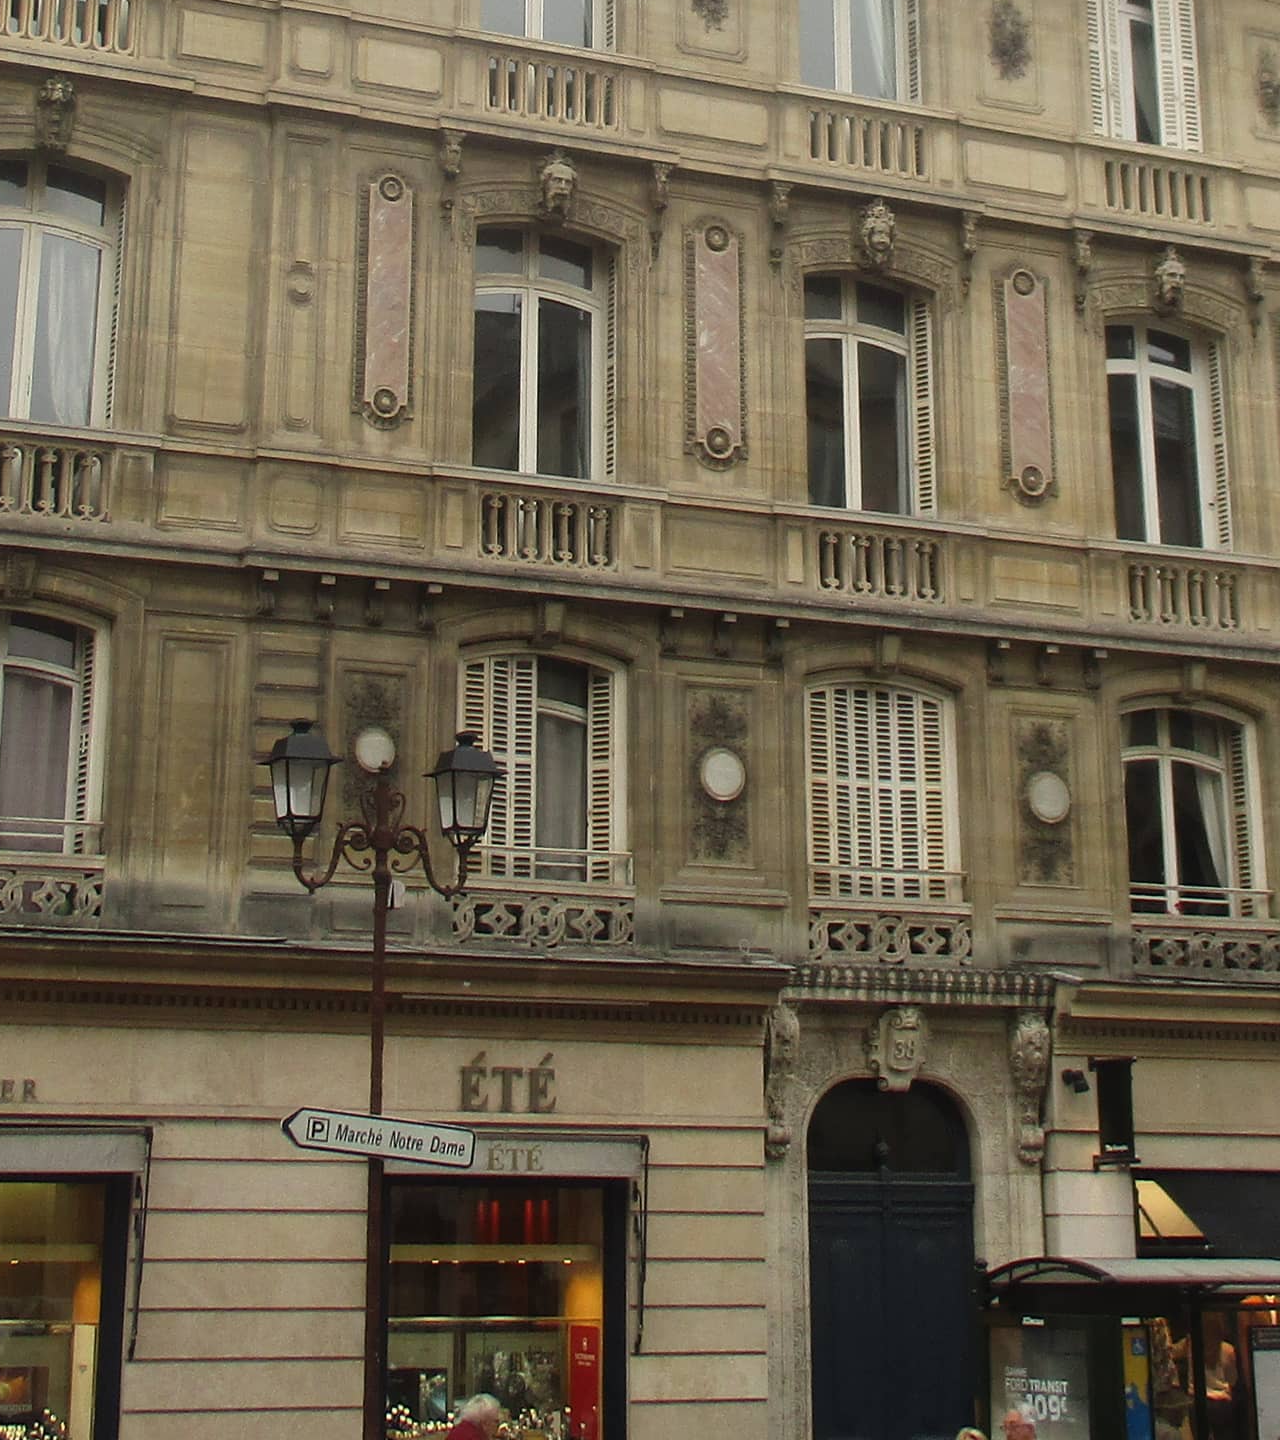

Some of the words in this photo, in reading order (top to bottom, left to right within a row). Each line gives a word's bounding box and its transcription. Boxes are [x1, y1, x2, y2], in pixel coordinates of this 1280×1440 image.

[460, 1051, 557, 1113] ÉTÉ
[311, 1121, 326, 1138] P
[335, 1123, 383, 1147] Marché
[389, 1132, 424, 1152] Notre
[430, 1135, 466, 1157] Dame
[486, 1144, 544, 1172] ÉTÉ
[1005, 1378, 1028, 1392] FORD
[1029, 1379, 1068, 1394] TRANSIT
